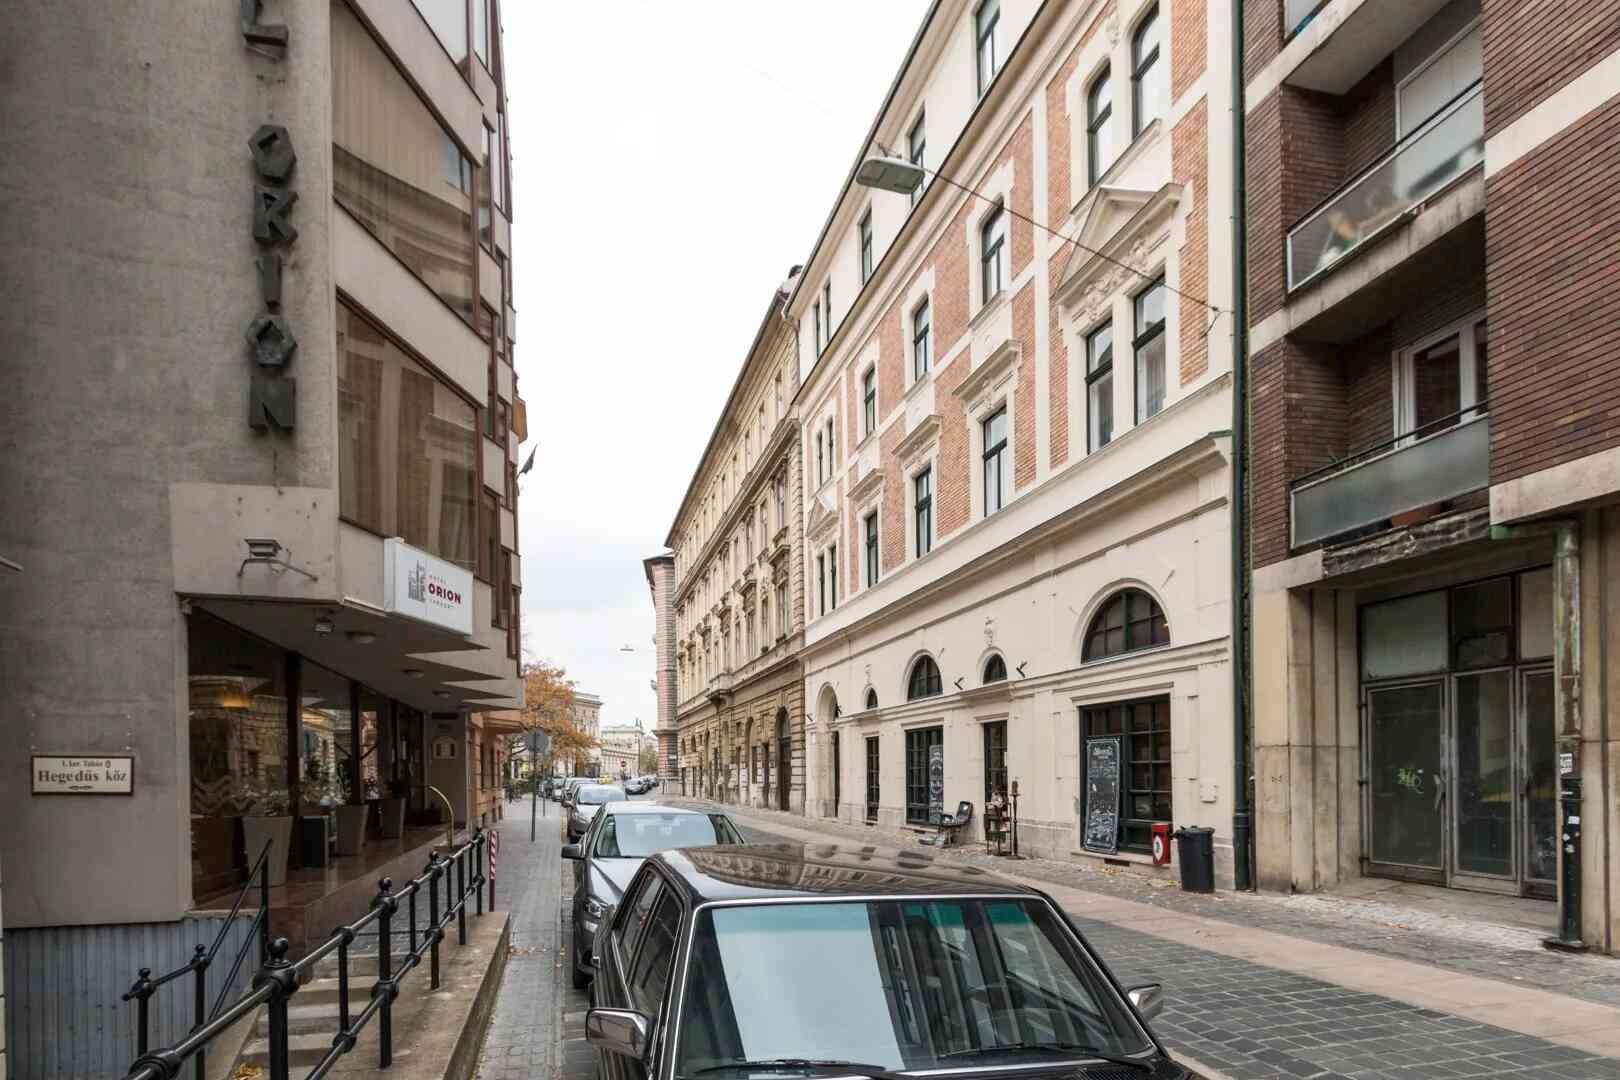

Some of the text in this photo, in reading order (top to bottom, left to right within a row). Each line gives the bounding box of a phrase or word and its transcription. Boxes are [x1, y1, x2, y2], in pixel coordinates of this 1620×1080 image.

[247, 124, 298, 431] ORION
[428, 583, 462, 605] ORION
[105, 769, 127, 782] köz
